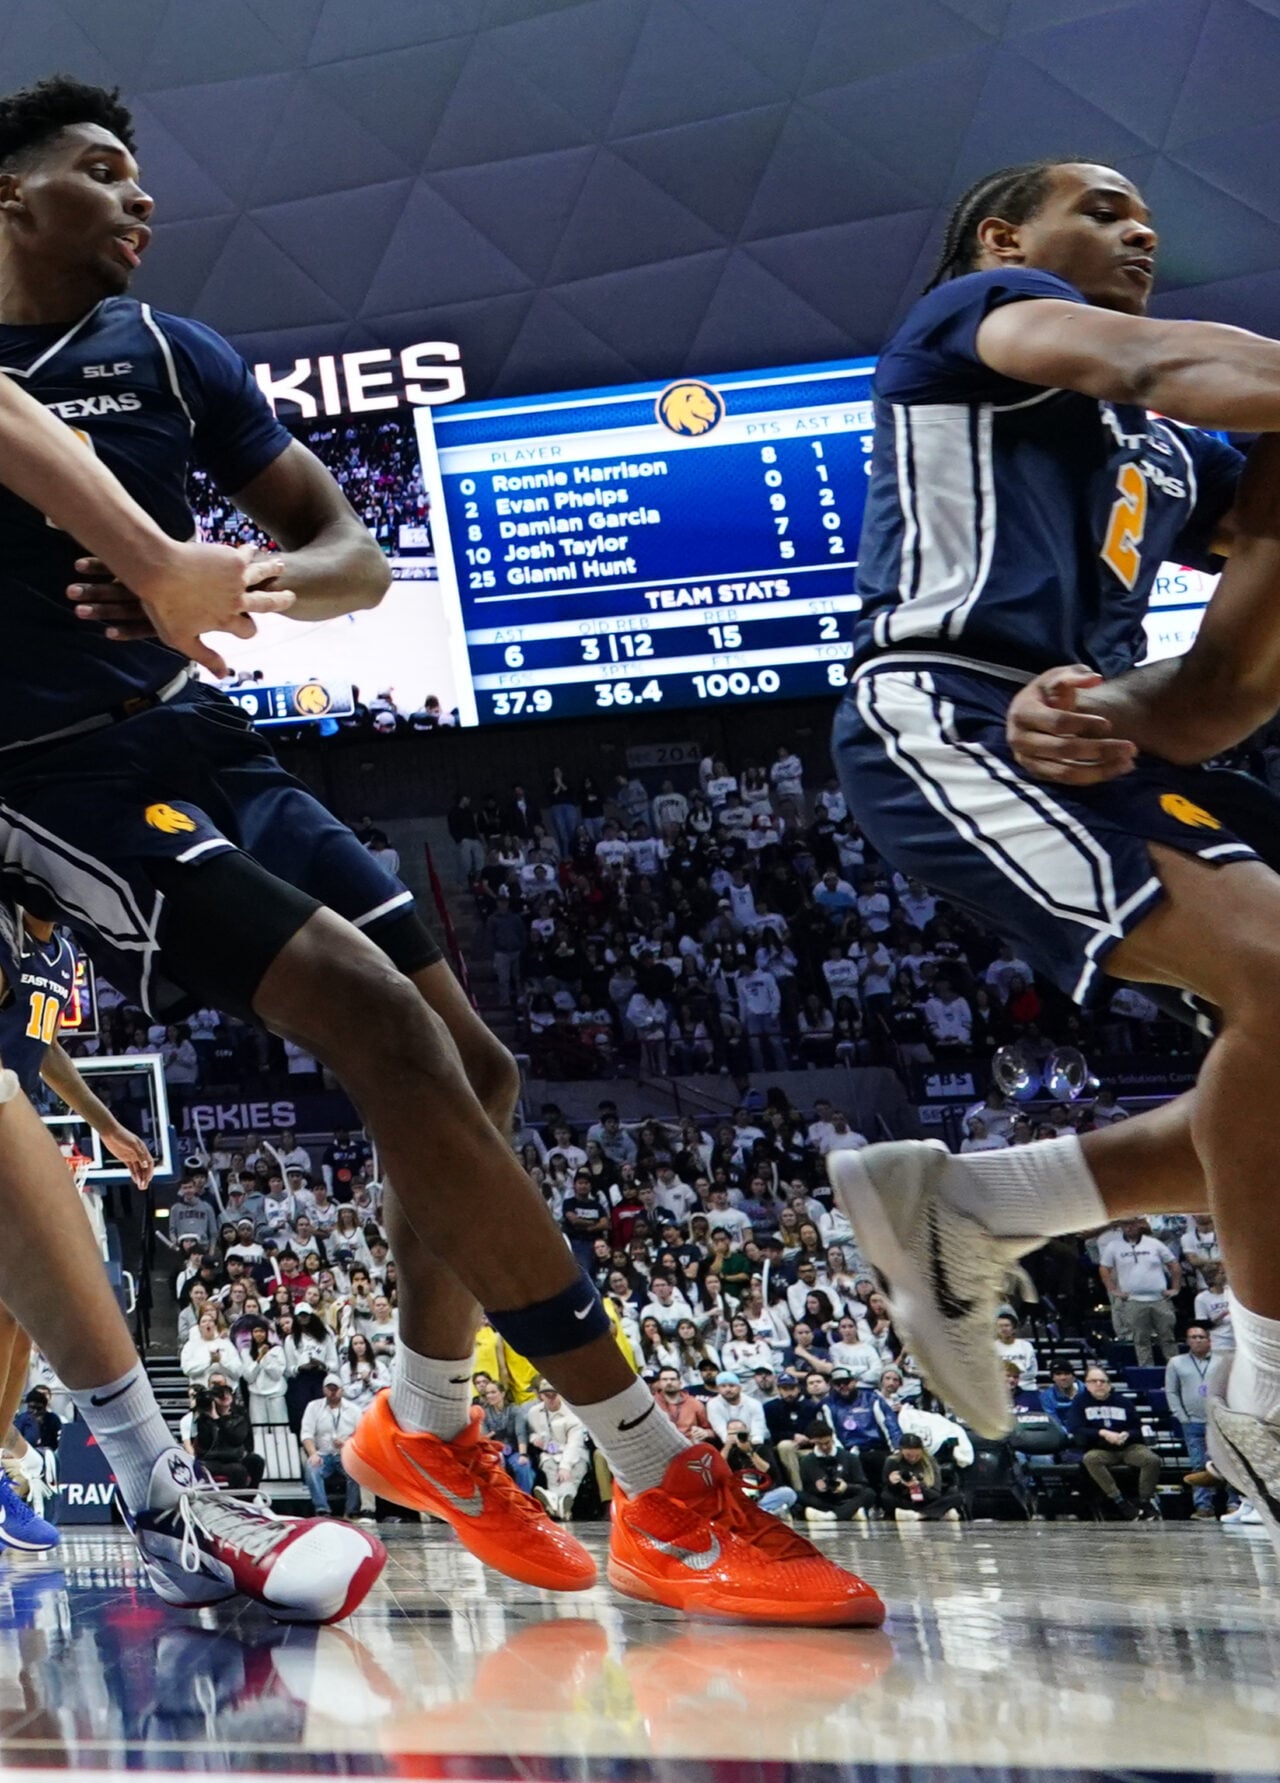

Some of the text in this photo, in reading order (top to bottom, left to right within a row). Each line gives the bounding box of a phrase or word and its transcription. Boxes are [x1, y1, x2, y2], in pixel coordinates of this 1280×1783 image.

[491, 446, 561, 463] PLAYER
[746, 421, 781, 435] PTS
[795, 416, 830, 430] AST
[460, 479, 476, 495] 0
[492, 470, 568, 492] Ronnie
[573, 461, 668, 484] Harrison
[761, 446, 777, 463] 8
[811, 441, 823, 458] 1
[465, 465, 828, 518] 2 Evan Phelps 0 1
[466, 512, 840, 565] 10 Josh Taylor 7 0
[468, 488, 835, 541] 8 Damian Garcia 9 2
[469, 536, 845, 589] 25 Gianni Hunt 5 2
[1156, 576, 1188, 595] RS
[645, 579, 790, 609] TEAM STATS
[494, 629, 524, 643] AST
[616, 616, 650, 631] REB
[704, 609, 738, 624] REB
[809, 600, 840, 614] STL
[504, 645, 524, 667] 6
[581, 638, 600, 661] 3
[708, 625, 742, 649] 15
[818, 616, 841, 639] 2
[815, 644, 851, 657] TOV
[492, 663, 848, 715] 37.9 36.4 100.0 8
[656, 746, 699, 763] 204
[21, 973, 48, 988] EAST
[26, 991, 60, 1045] 10
